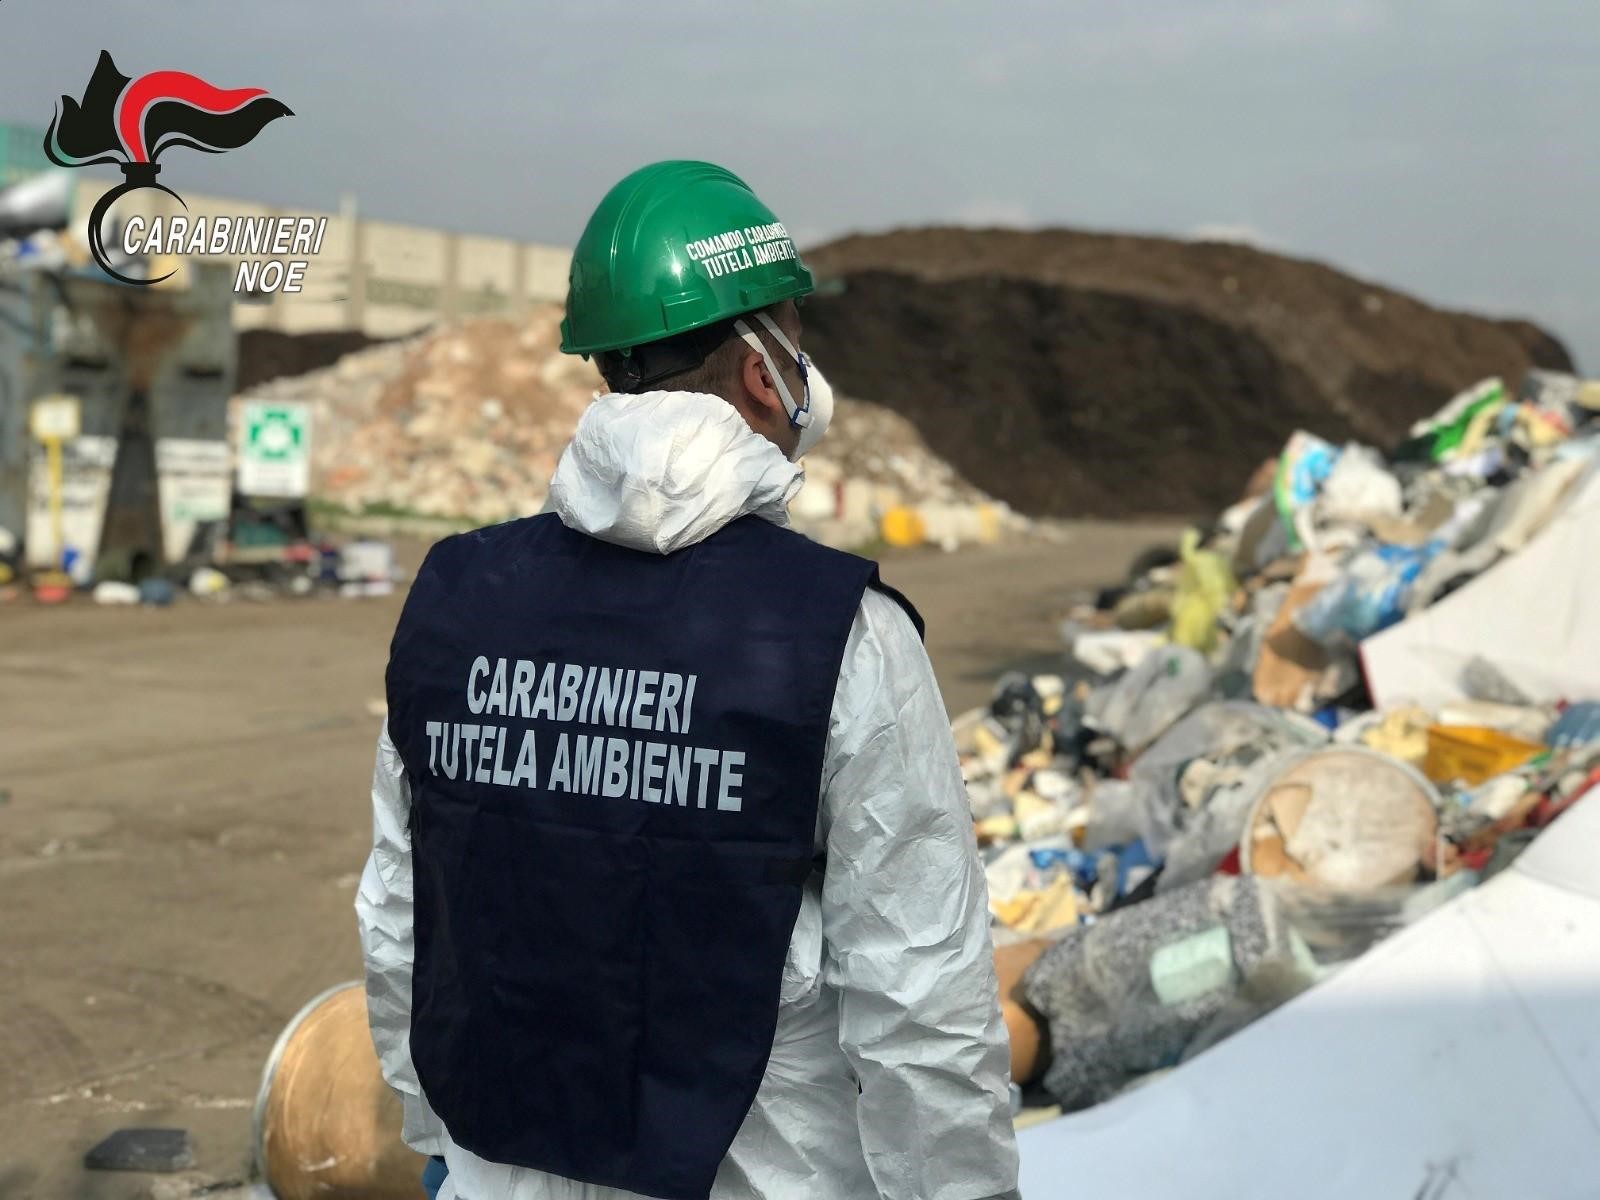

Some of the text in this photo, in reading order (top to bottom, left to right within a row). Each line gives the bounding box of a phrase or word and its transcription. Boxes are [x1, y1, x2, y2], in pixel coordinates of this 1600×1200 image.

[686, 230, 745, 260] COMANDO
[702, 239, 795, 279] TUTELA AMBIENTE
[467, 655, 697, 734] CARABINIERI
[425, 721, 746, 812] TUTELA AMBIENTE
